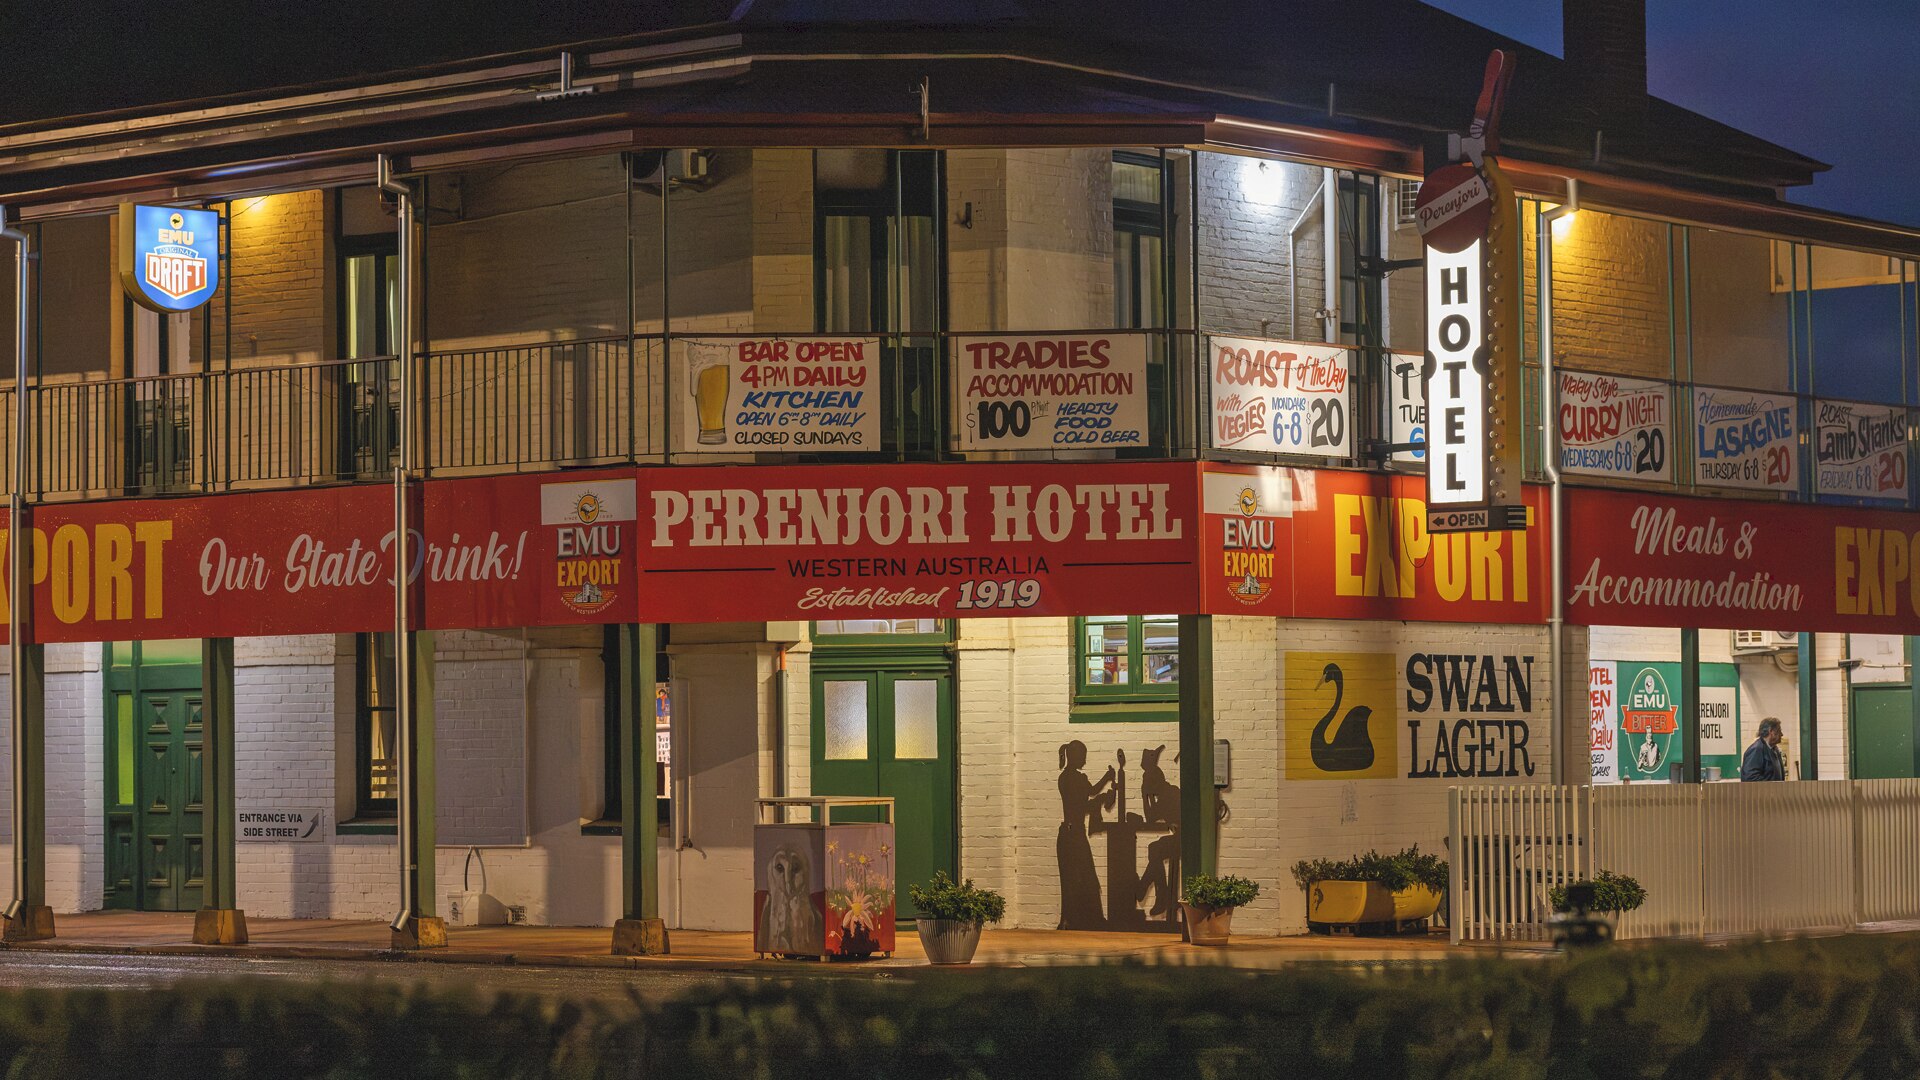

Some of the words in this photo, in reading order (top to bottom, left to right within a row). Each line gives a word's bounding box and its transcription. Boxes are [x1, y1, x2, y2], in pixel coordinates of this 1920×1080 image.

[1420, 181, 1480, 228] Perenjori
[158, 228, 194, 246] EMU
[149, 256, 203, 294] DRAFT
[738, 341, 789, 363] BAR
[796, 341, 864, 362] OPEN
[966, 339, 1111, 369] TRADIES
[793, 366, 867, 388] DAILY
[1215, 345, 1298, 390] ROAST
[1297, 355, 1312, 388] of
[1310, 358, 1326, 386] the
[1326, 357, 1347, 394] Day
[1438, 266, 1471, 491] HOTEL
[966, 372, 1133, 397] ACCOMMODATION
[1561, 374, 1591, 402] Malay
[1592, 376, 1619, 403] Style
[742, 391, 864, 409] KITCHEN
[1056, 402, 1119, 416] HEARTY
[1216, 393, 1242, 412] with
[1272, 396, 1306, 411] MONDAYS
[1698, 391, 1759, 423] Homemade
[736, 412, 776, 426] OPEN
[819, 412, 867, 428] DAILY
[1054, 417, 1112, 429] FOOD
[1217, 401, 1266, 441] VEGIES
[1273, 411, 1302, 446] 6-8
[1559, 401, 1623, 443] CURRY
[1626, 394, 1665, 427] NIGHT
[735, 431, 789, 445] CLOSED
[793, 431, 863, 445] SUNDAYS
[1053, 431, 1098, 443] COLD
[1101, 430, 1140, 443] BEER
[1698, 406, 1793, 459] LASAGNE
[1817, 421, 1857, 463] Lamb
[1858, 409, 1905, 458] Shanks
[1561, 447, 1614, 471] WEDNESDAYS
[1700, 460, 1742, 481] THURSDAY
[650, 485, 970, 547] PERENJORI
[990, 483, 1183, 543] HOTEL
[1447, 512, 1486, 527] OPEN
[556, 524, 621, 559] EMU
[1223, 518, 1275, 552] EMU
[1630, 506, 1729, 556] Meals
[1734, 521, 1757, 560] &
[0, 520, 173, 625] PORT
[199, 537, 271, 595] Our
[284, 533, 382, 593] State
[380, 528, 528, 587] Drink!
[557, 559, 621, 587] EXPORT
[788, 558, 906, 578] WESTERN
[915, 556, 1050, 576] AUSTRALIA
[1223, 551, 1275, 578] EXPORT
[797, 586, 950, 610] Established
[955, 578, 1042, 610] 1919
[1567, 557, 1804, 612] Accommodation
[1405, 652, 1535, 713] SWAN
[1634, 694, 1665, 709] EMU
[1632, 714, 1667, 730] BITTER
[1700, 723, 1724, 739] HOTEL
[1407, 718, 1535, 778] LAGER
[1591, 725, 1613, 751] Daily
[239, 813, 286, 823] ENTRANCE
[288, 813, 303, 823] VIA
[243, 827, 263, 837] SIDE
[265, 827, 299, 837] STREET
